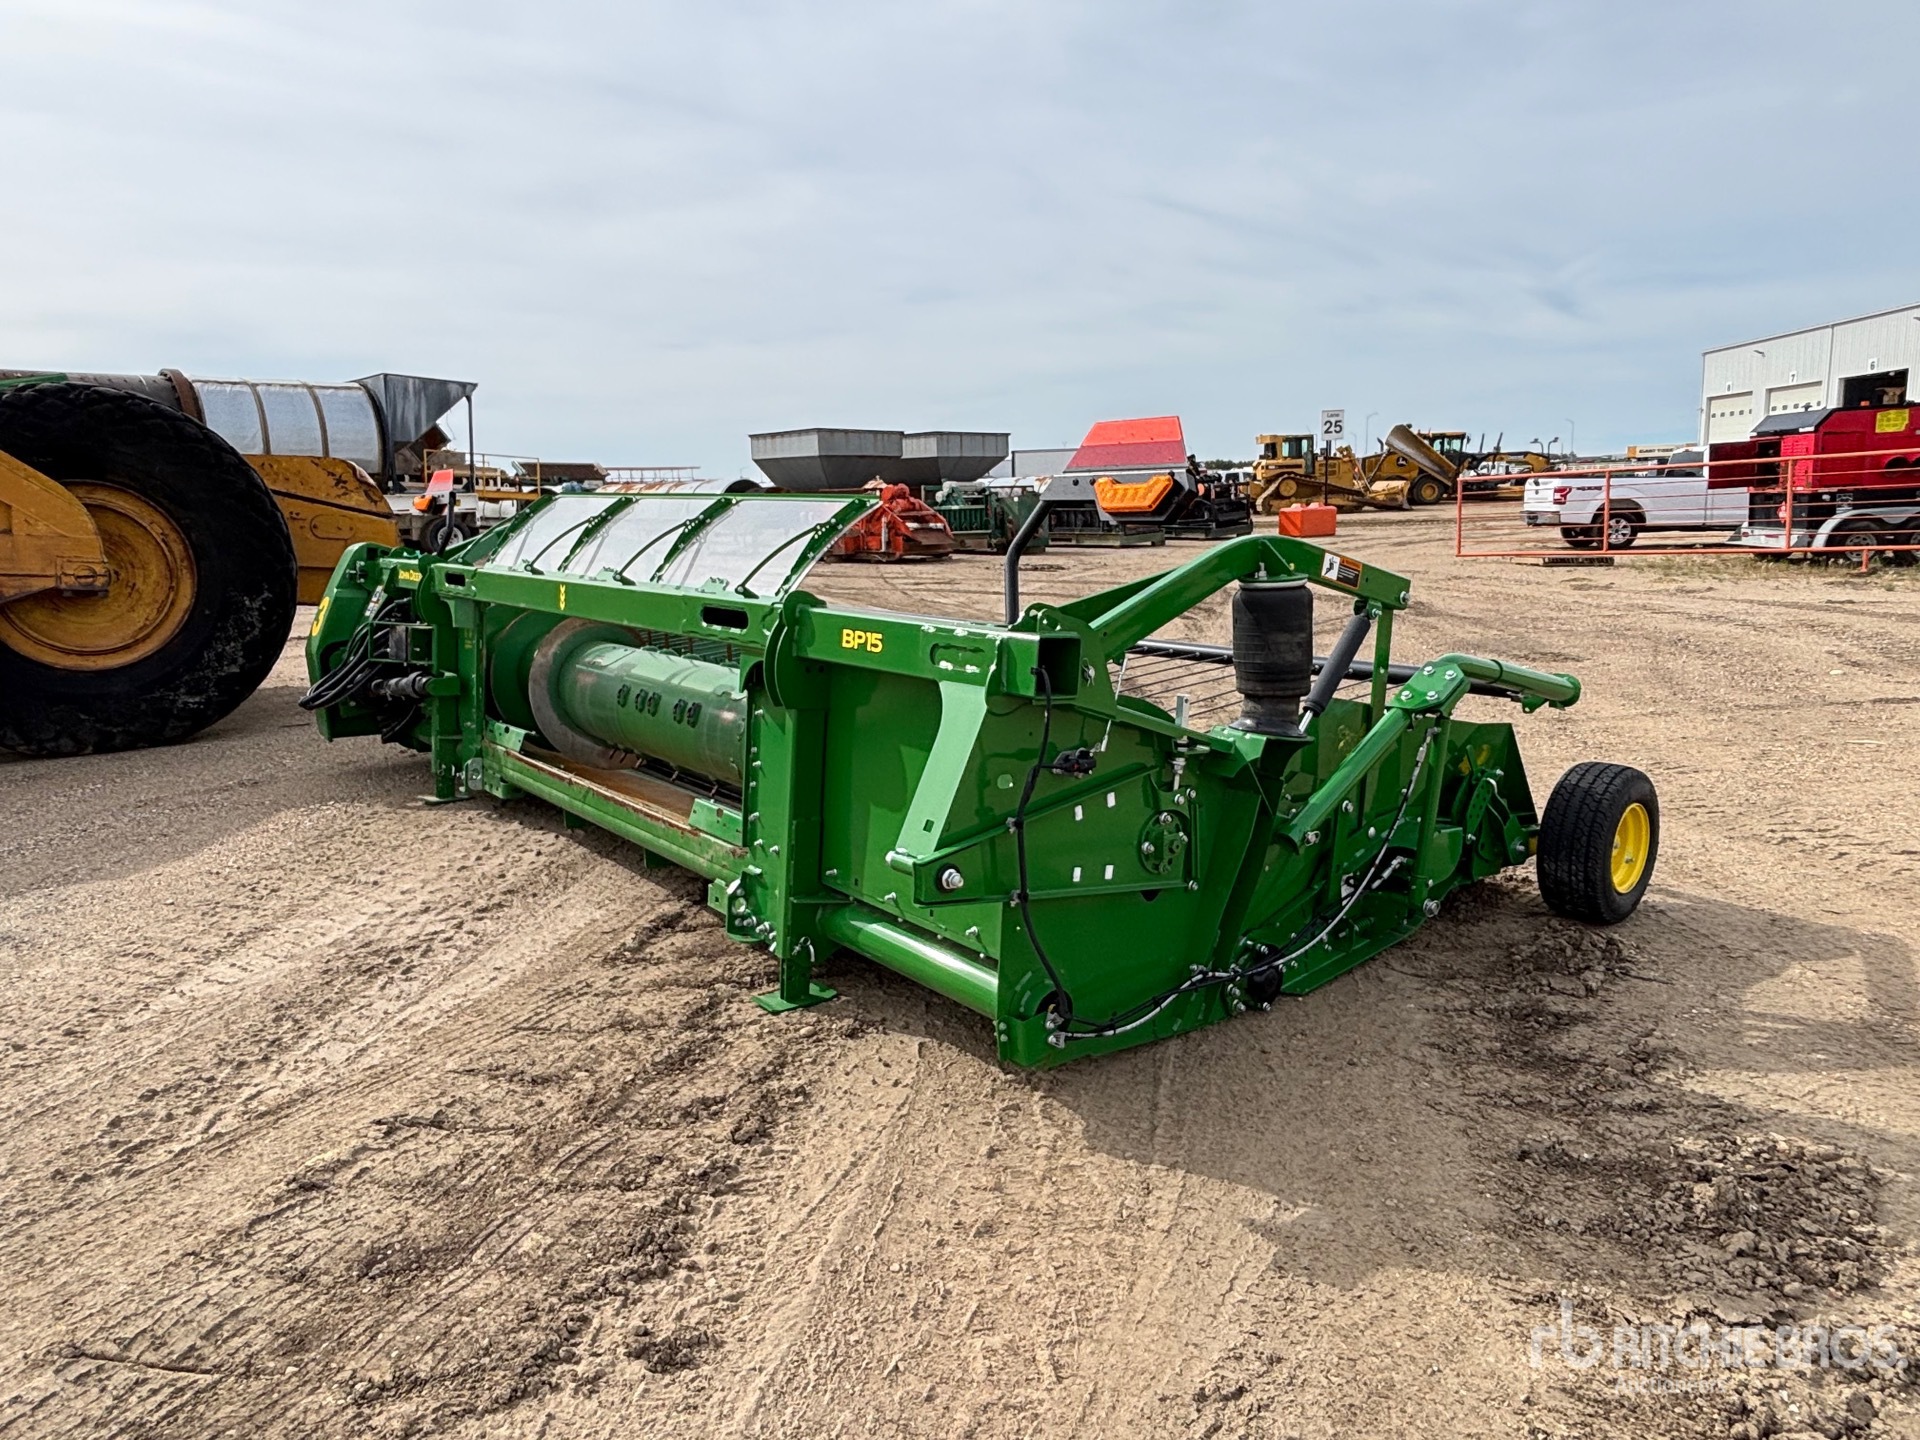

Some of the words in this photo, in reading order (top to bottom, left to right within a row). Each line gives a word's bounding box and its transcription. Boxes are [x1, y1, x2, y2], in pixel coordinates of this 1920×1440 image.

[1870, 360, 1876, 371] 6
[1791, 373, 1796, 383] 7
[1323, 420, 1343, 434] 25
[841, 628, 883, 653] BP15
